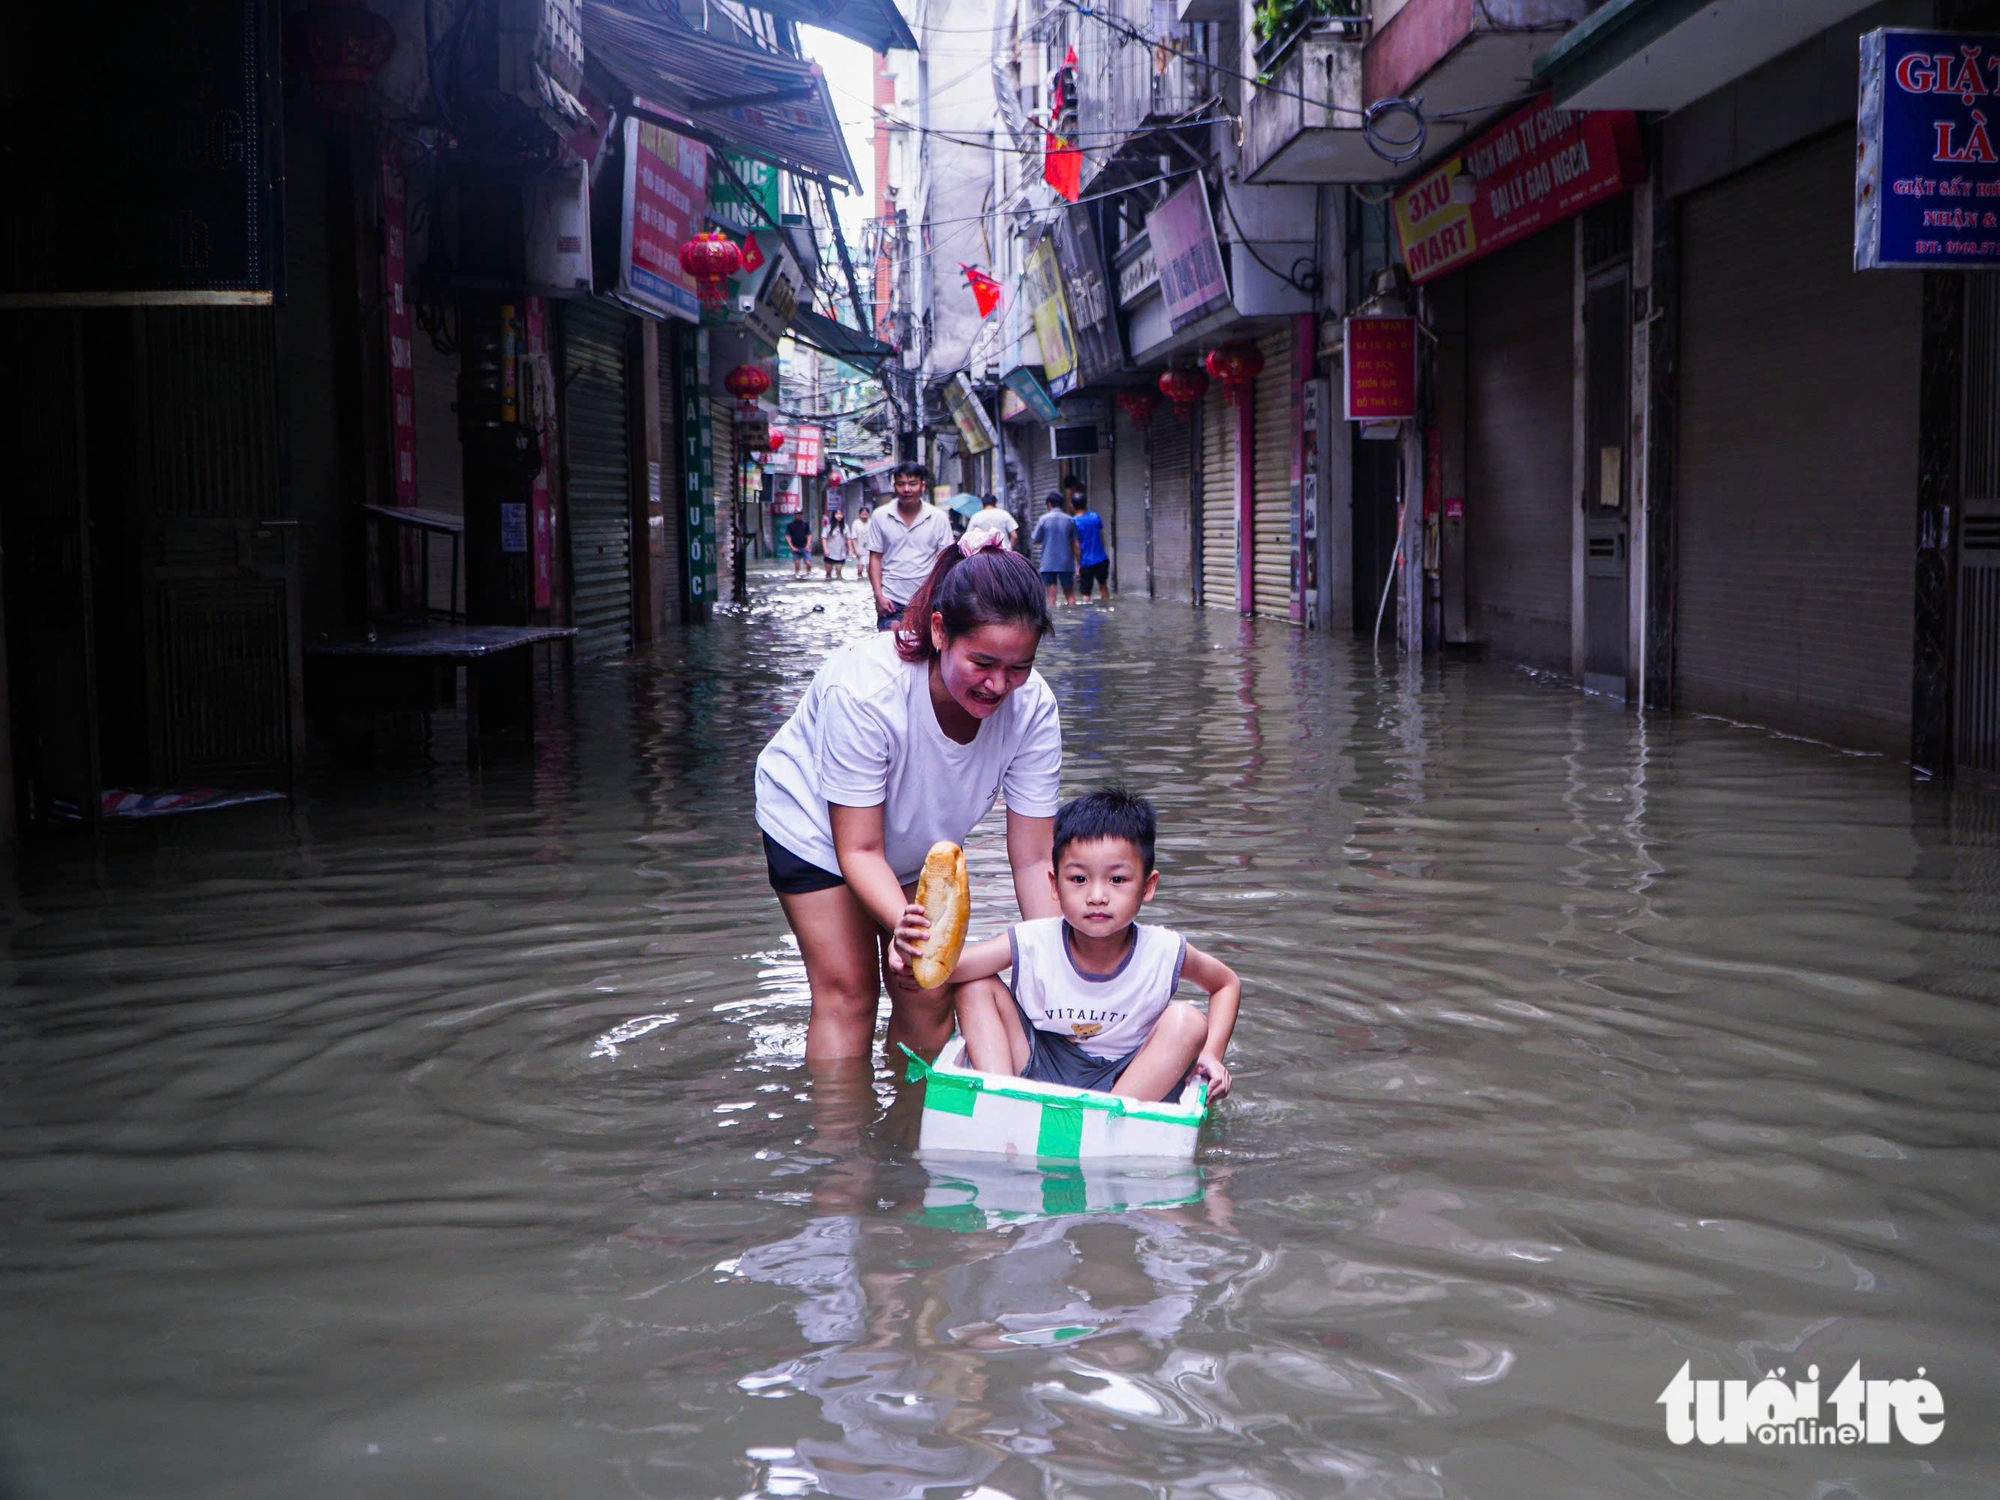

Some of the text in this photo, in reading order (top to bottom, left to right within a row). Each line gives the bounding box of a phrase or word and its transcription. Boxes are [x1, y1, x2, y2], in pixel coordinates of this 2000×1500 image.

[1496, 124, 1521, 164] HÓA
[1932, 108, 1999, 163] LÀ
[1407, 174, 1451, 223] 3XU
[1525, 162, 1552, 204] GẠO
[1893, 177, 1937, 199] GIẶT
[1939, 176, 1973, 197] SẤY
[1923, 208, 1998, 231] NHẬN &
[1408, 219, 1468, 275] MART
